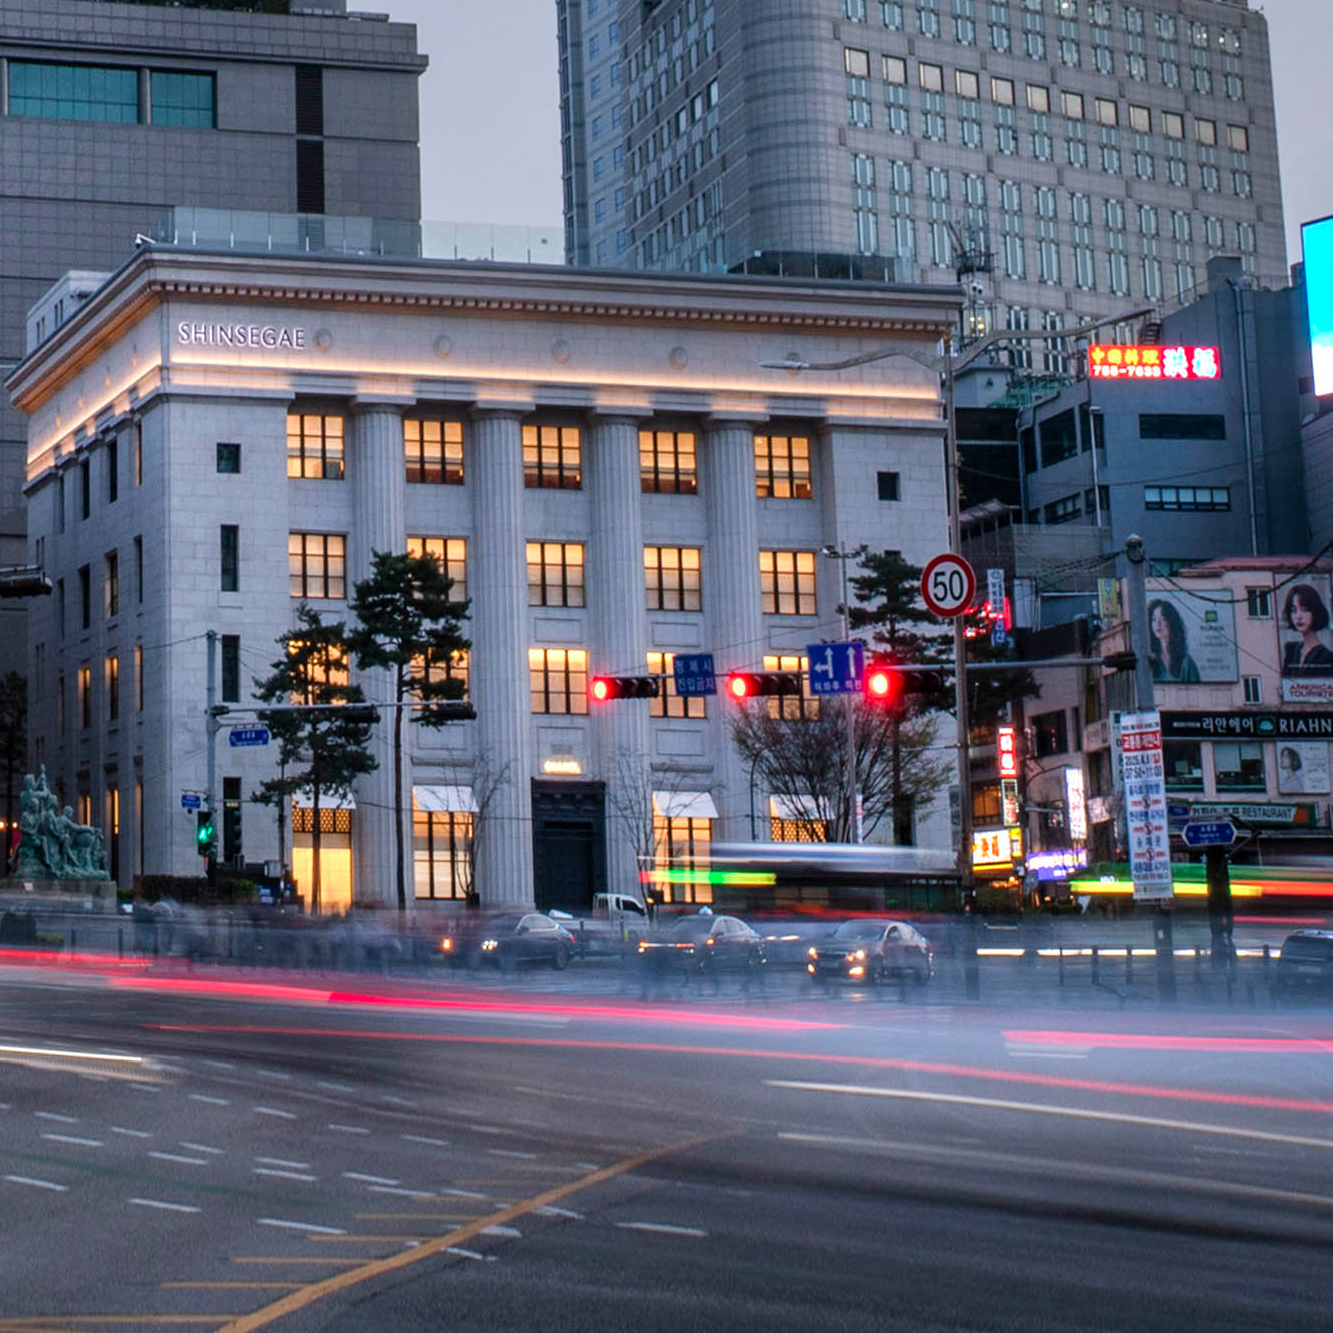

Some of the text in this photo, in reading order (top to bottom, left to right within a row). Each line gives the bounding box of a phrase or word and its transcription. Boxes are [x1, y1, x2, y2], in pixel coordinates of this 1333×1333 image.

[178, 321, 305, 349] SHINSEGAE
[933, 569, 964, 602] 50
[1278, 718, 1332, 733] RIAHN
